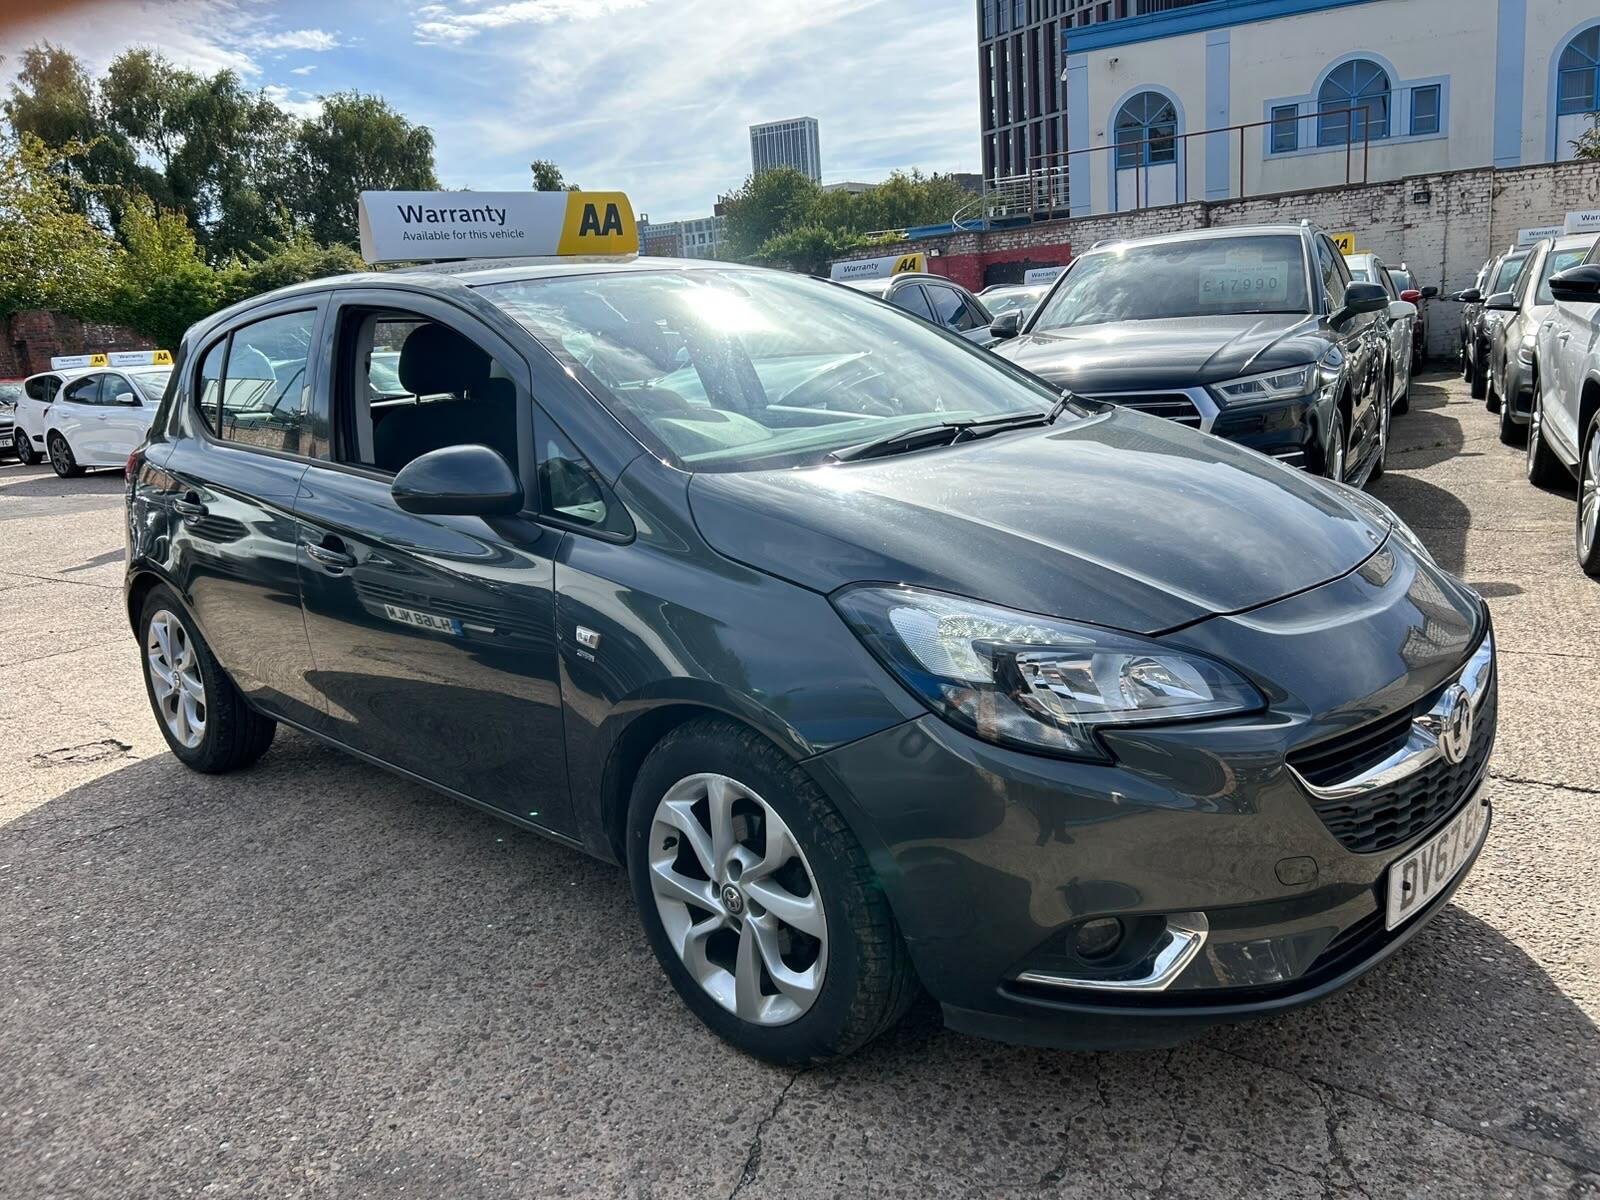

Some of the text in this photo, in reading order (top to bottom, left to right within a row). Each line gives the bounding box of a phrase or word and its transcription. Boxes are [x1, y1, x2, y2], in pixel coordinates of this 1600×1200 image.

[397, 205, 506, 226] Warranty
[578, 203, 624, 237] AA
[403, 228, 525, 241] Available for this vehicle
[843, 262, 880, 273] Warranty
[898, 257, 917, 272] AA
[1031, 270, 1058, 278] Warranty
[94, 355, 105, 363] AA
[157, 352, 169, 361] AA
[1400, 818, 1462, 912] DV67
